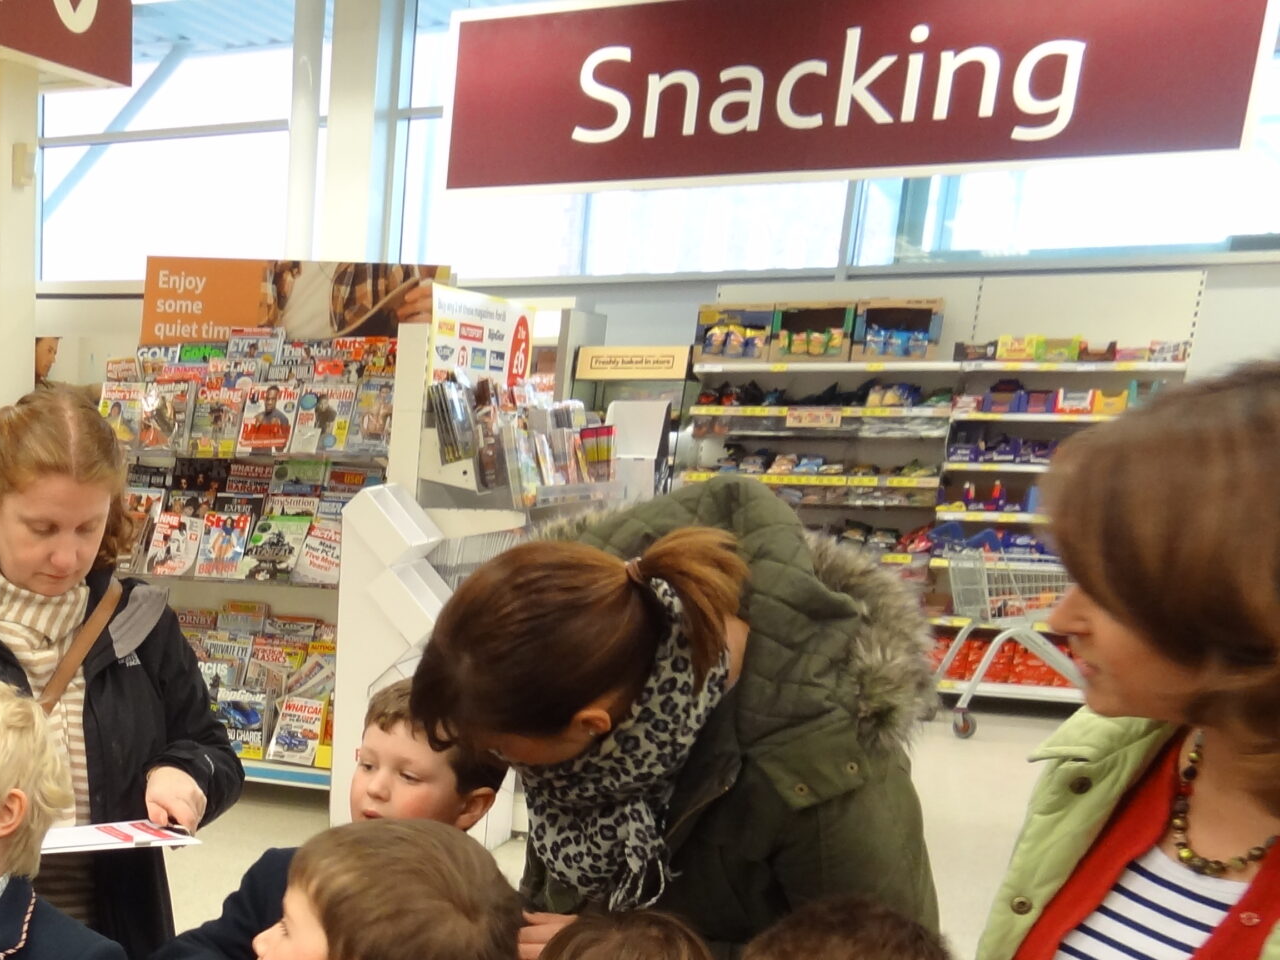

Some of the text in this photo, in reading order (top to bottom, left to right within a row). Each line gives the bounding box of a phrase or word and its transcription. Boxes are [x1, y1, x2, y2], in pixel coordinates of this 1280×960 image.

[571, 24, 1088, 144] Snacking
[158, 270, 207, 294] Enjoy
[156, 298, 203, 314] some
[154, 319, 229, 340] quiet tim
[513, 342, 526, 376] £6
[198, 387, 242, 402] Cycling
[231, 464, 254, 473] WHAT
[266, 496, 315, 509] PlayStation
[177, 613, 213, 626] ORNBY
[209, 642, 249, 658] PRIVATE EYE
[198, 661, 228, 674] OCUS
[218, 687, 267, 702] TopGear
[236, 729, 262, 744] CHARGE
